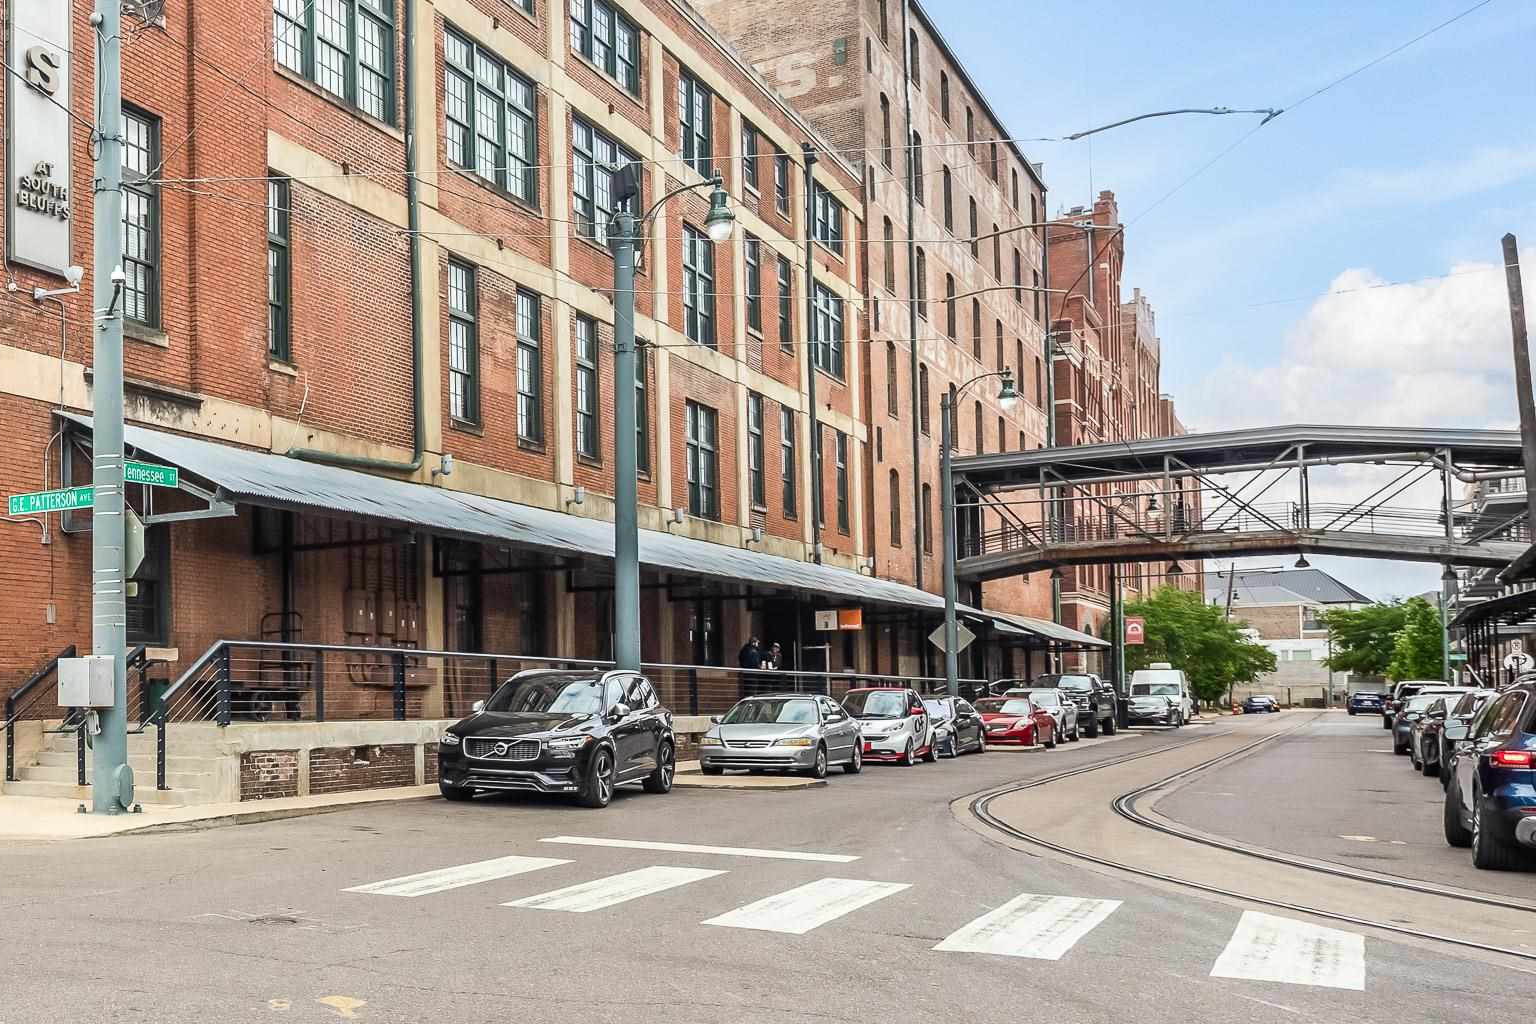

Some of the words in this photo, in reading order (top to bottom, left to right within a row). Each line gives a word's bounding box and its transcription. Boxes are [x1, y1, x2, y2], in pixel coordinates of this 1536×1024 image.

[34, 161, 55, 177] AT
[20, 175, 67, 201] SOUTH
[16, 190, 70, 220] BLUFFS
[30, 491, 77, 511] PATTERSON
[79, 494, 92, 502] AVE
